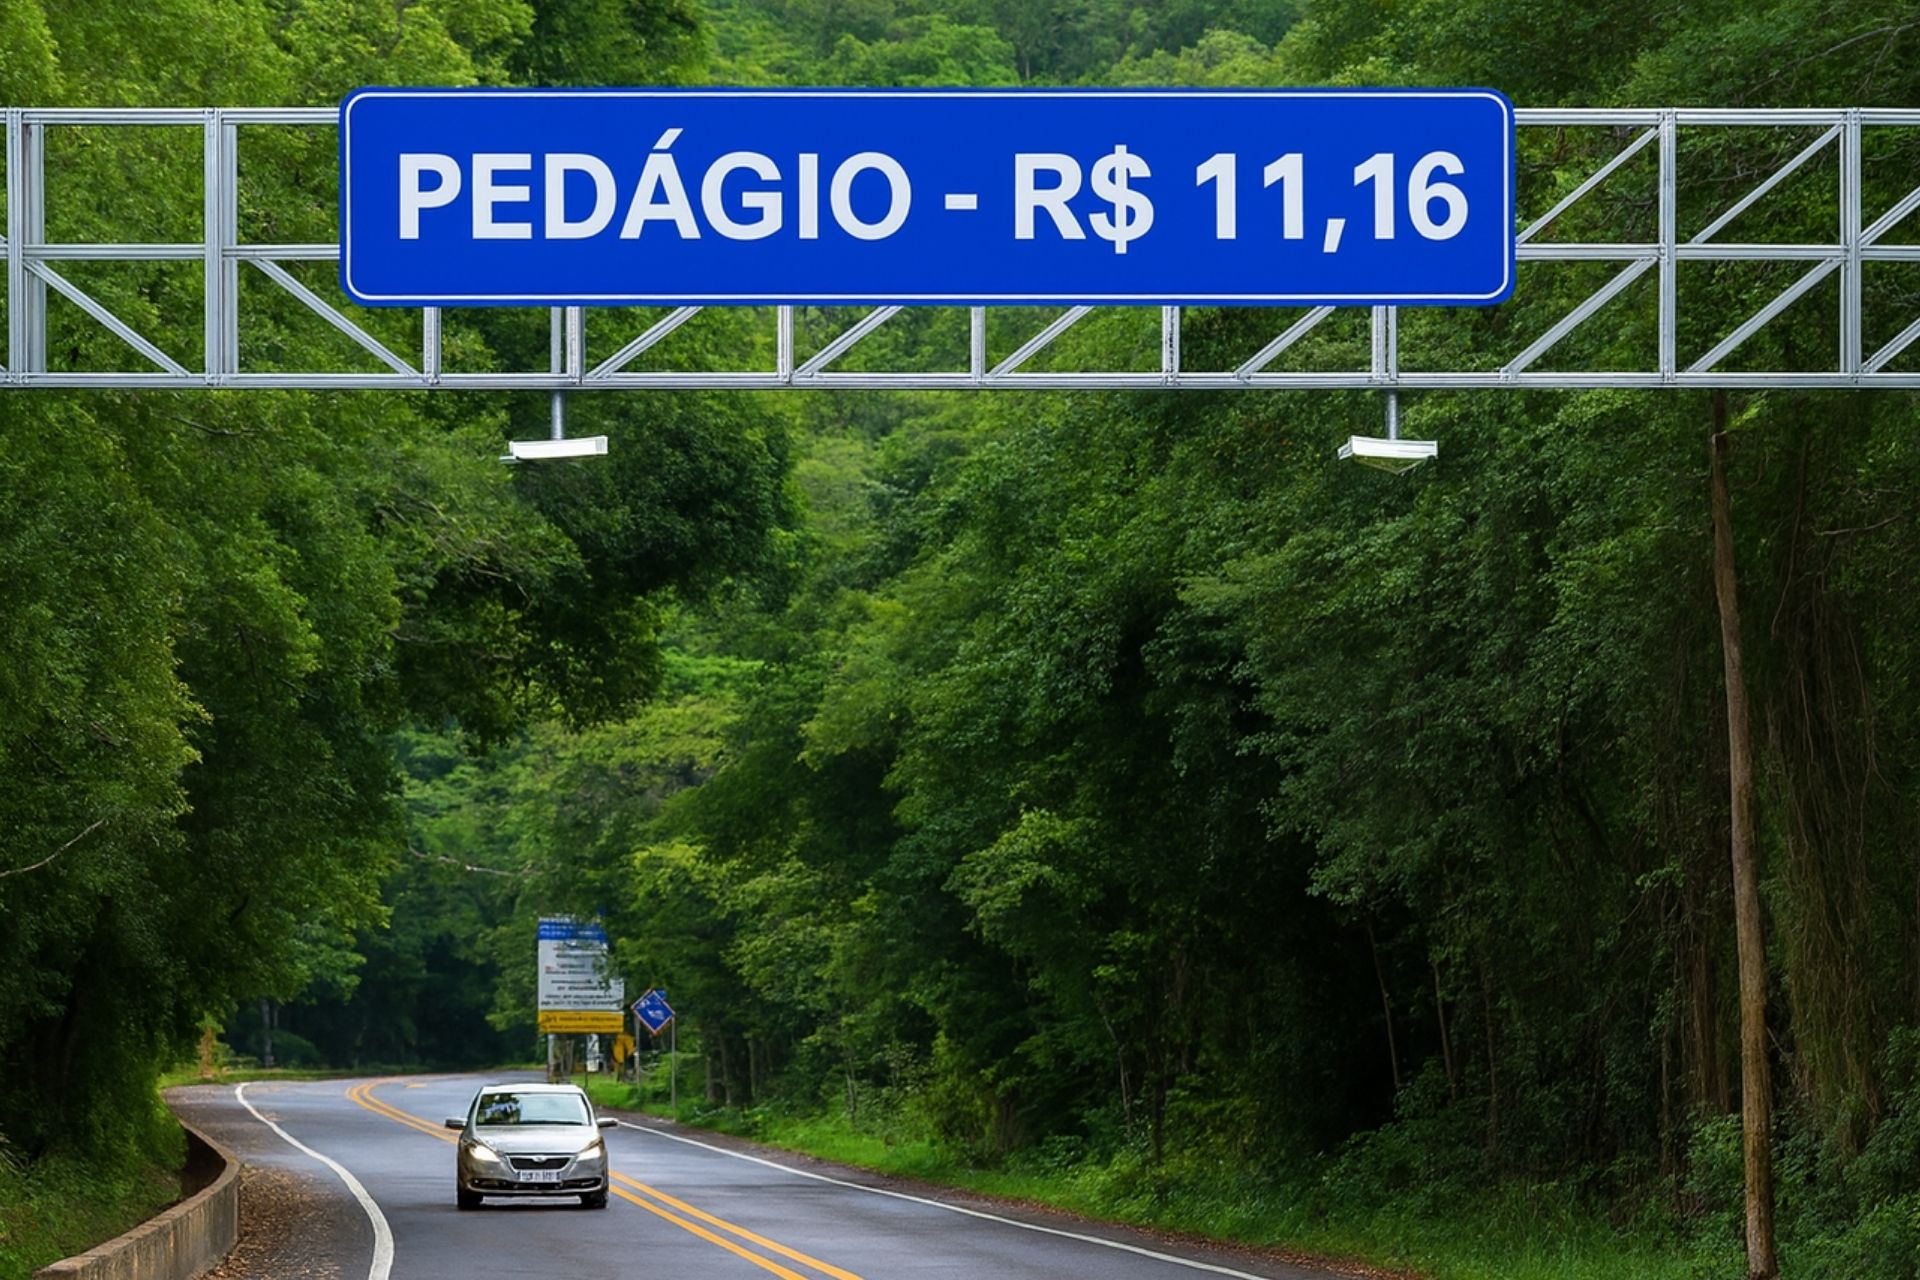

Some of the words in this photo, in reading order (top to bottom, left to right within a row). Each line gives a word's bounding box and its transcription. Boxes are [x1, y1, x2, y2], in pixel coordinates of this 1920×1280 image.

[399, 128, 912, 240] PEDÁGIO
[944, 193, 978, 209] -
[1014, 144, 1154, 254] R$
[1196, 151, 1469, 253] 11,16
